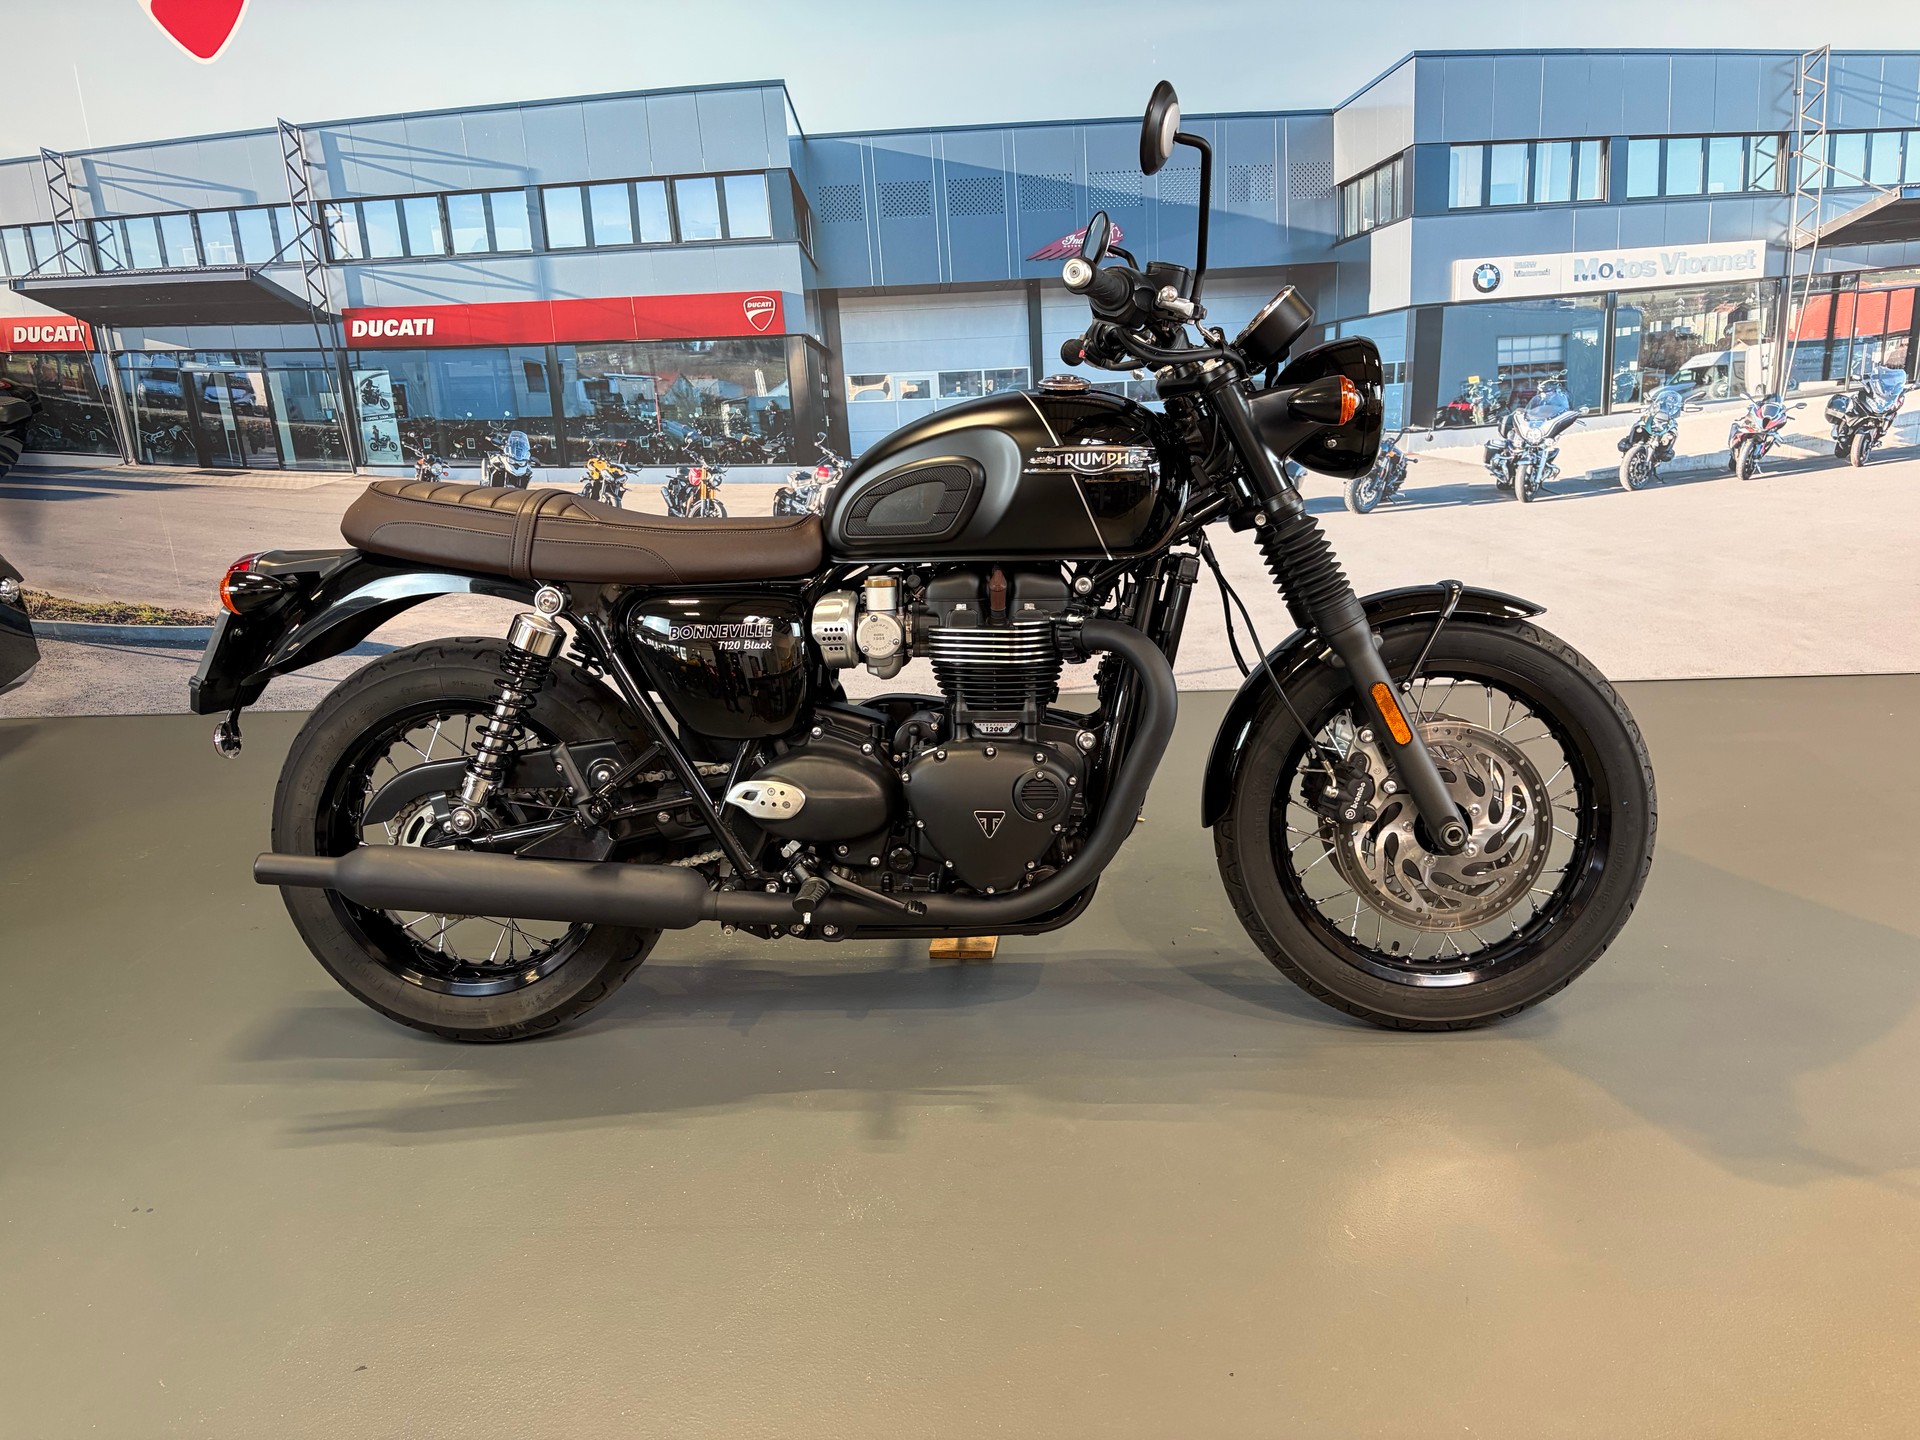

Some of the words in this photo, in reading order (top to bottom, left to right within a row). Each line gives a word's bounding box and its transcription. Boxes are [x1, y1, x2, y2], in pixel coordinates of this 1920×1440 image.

[1061, 234, 1085, 246] Ind
[1573, 257, 1657, 282] Motos
[1660, 249, 1757, 275] Vionnet
[13, 325, 85, 343] DUCATI
[352, 318, 434, 337] DUCATI
[1054, 452, 1130, 468] TRIUMPH
[669, 623, 773, 640] BONNEVILLE
[718, 640, 740, 650] T120
[743, 640, 772, 650] Black
[1350, 782, 1366, 809] brembo
